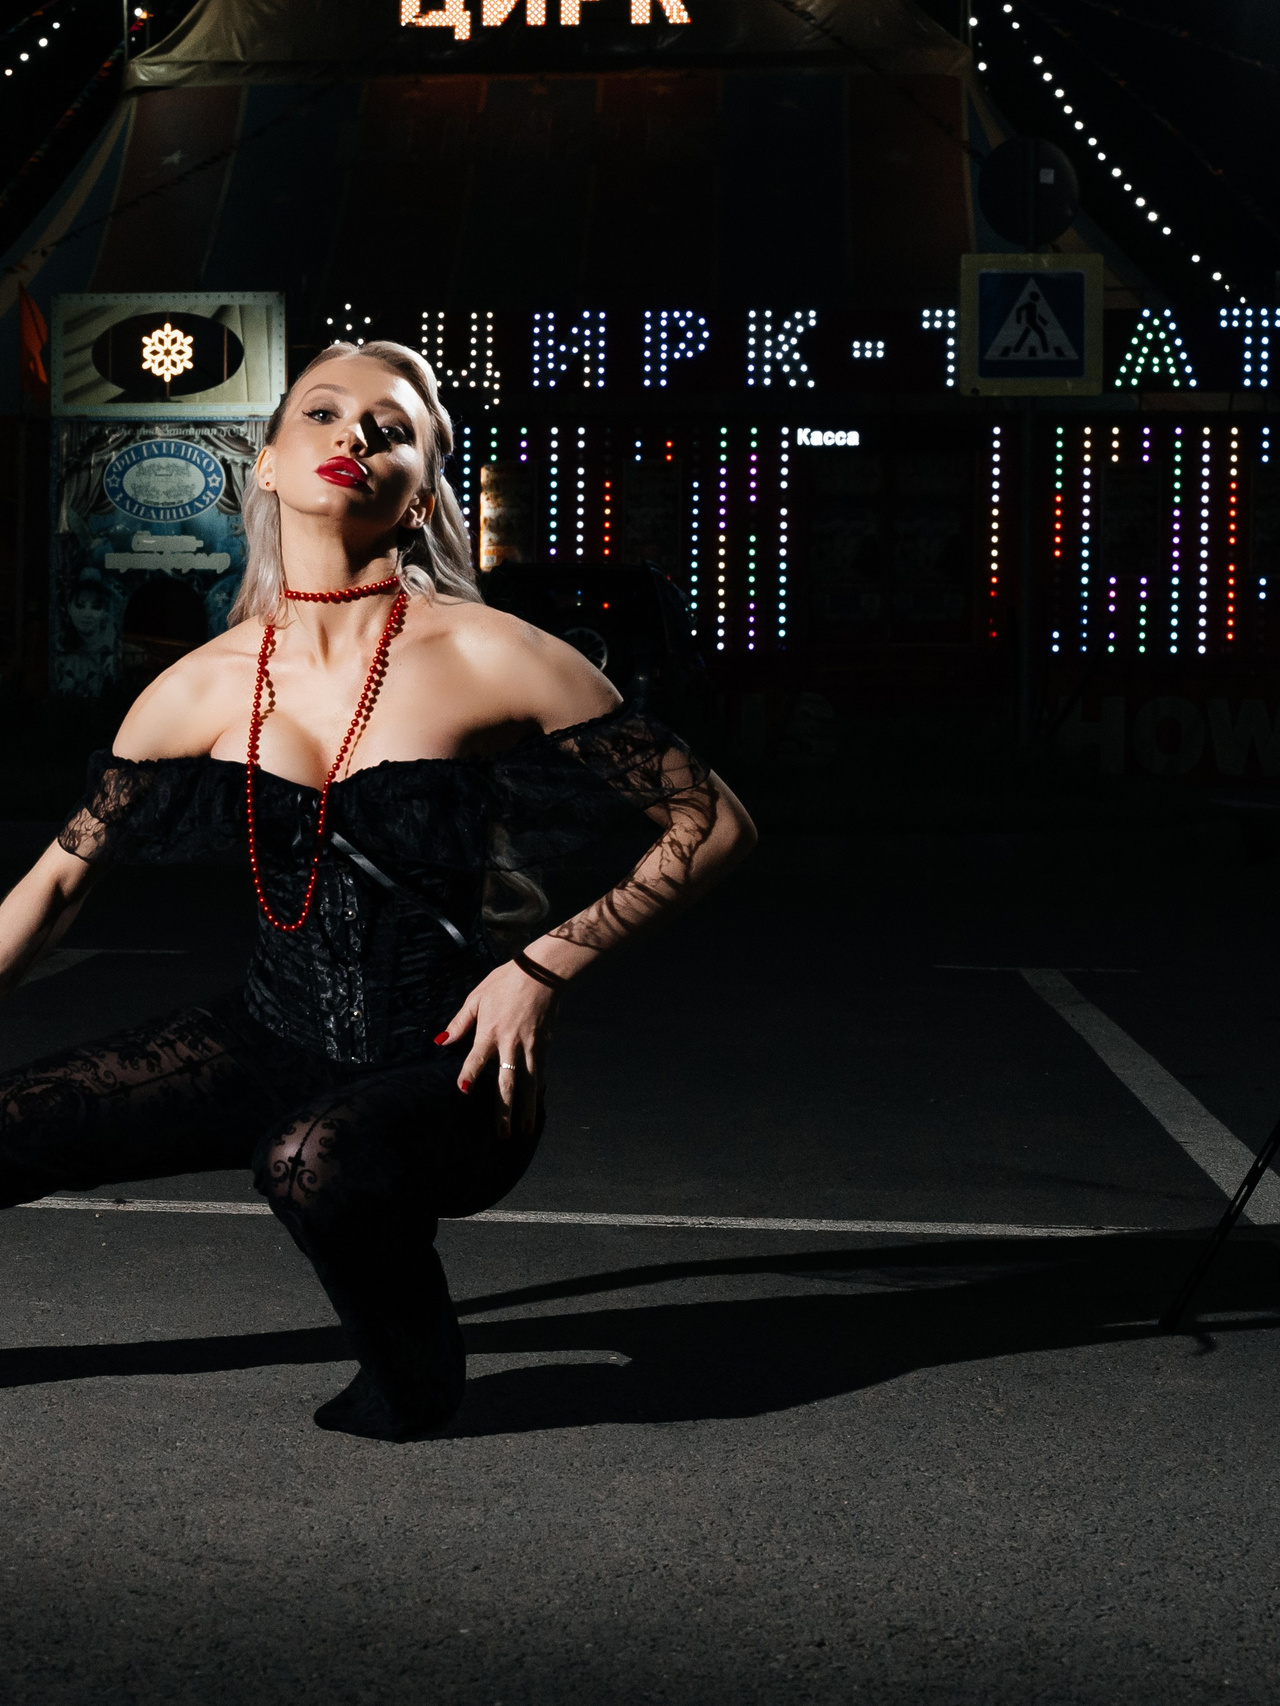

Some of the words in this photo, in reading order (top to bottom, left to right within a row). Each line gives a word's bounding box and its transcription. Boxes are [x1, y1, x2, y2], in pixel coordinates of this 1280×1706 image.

[420, 309, 1280, 409] ЦИРК-ТАТ
[797, 427, 860, 446] Касса
[1040, 694, 1280, 777] HOW
